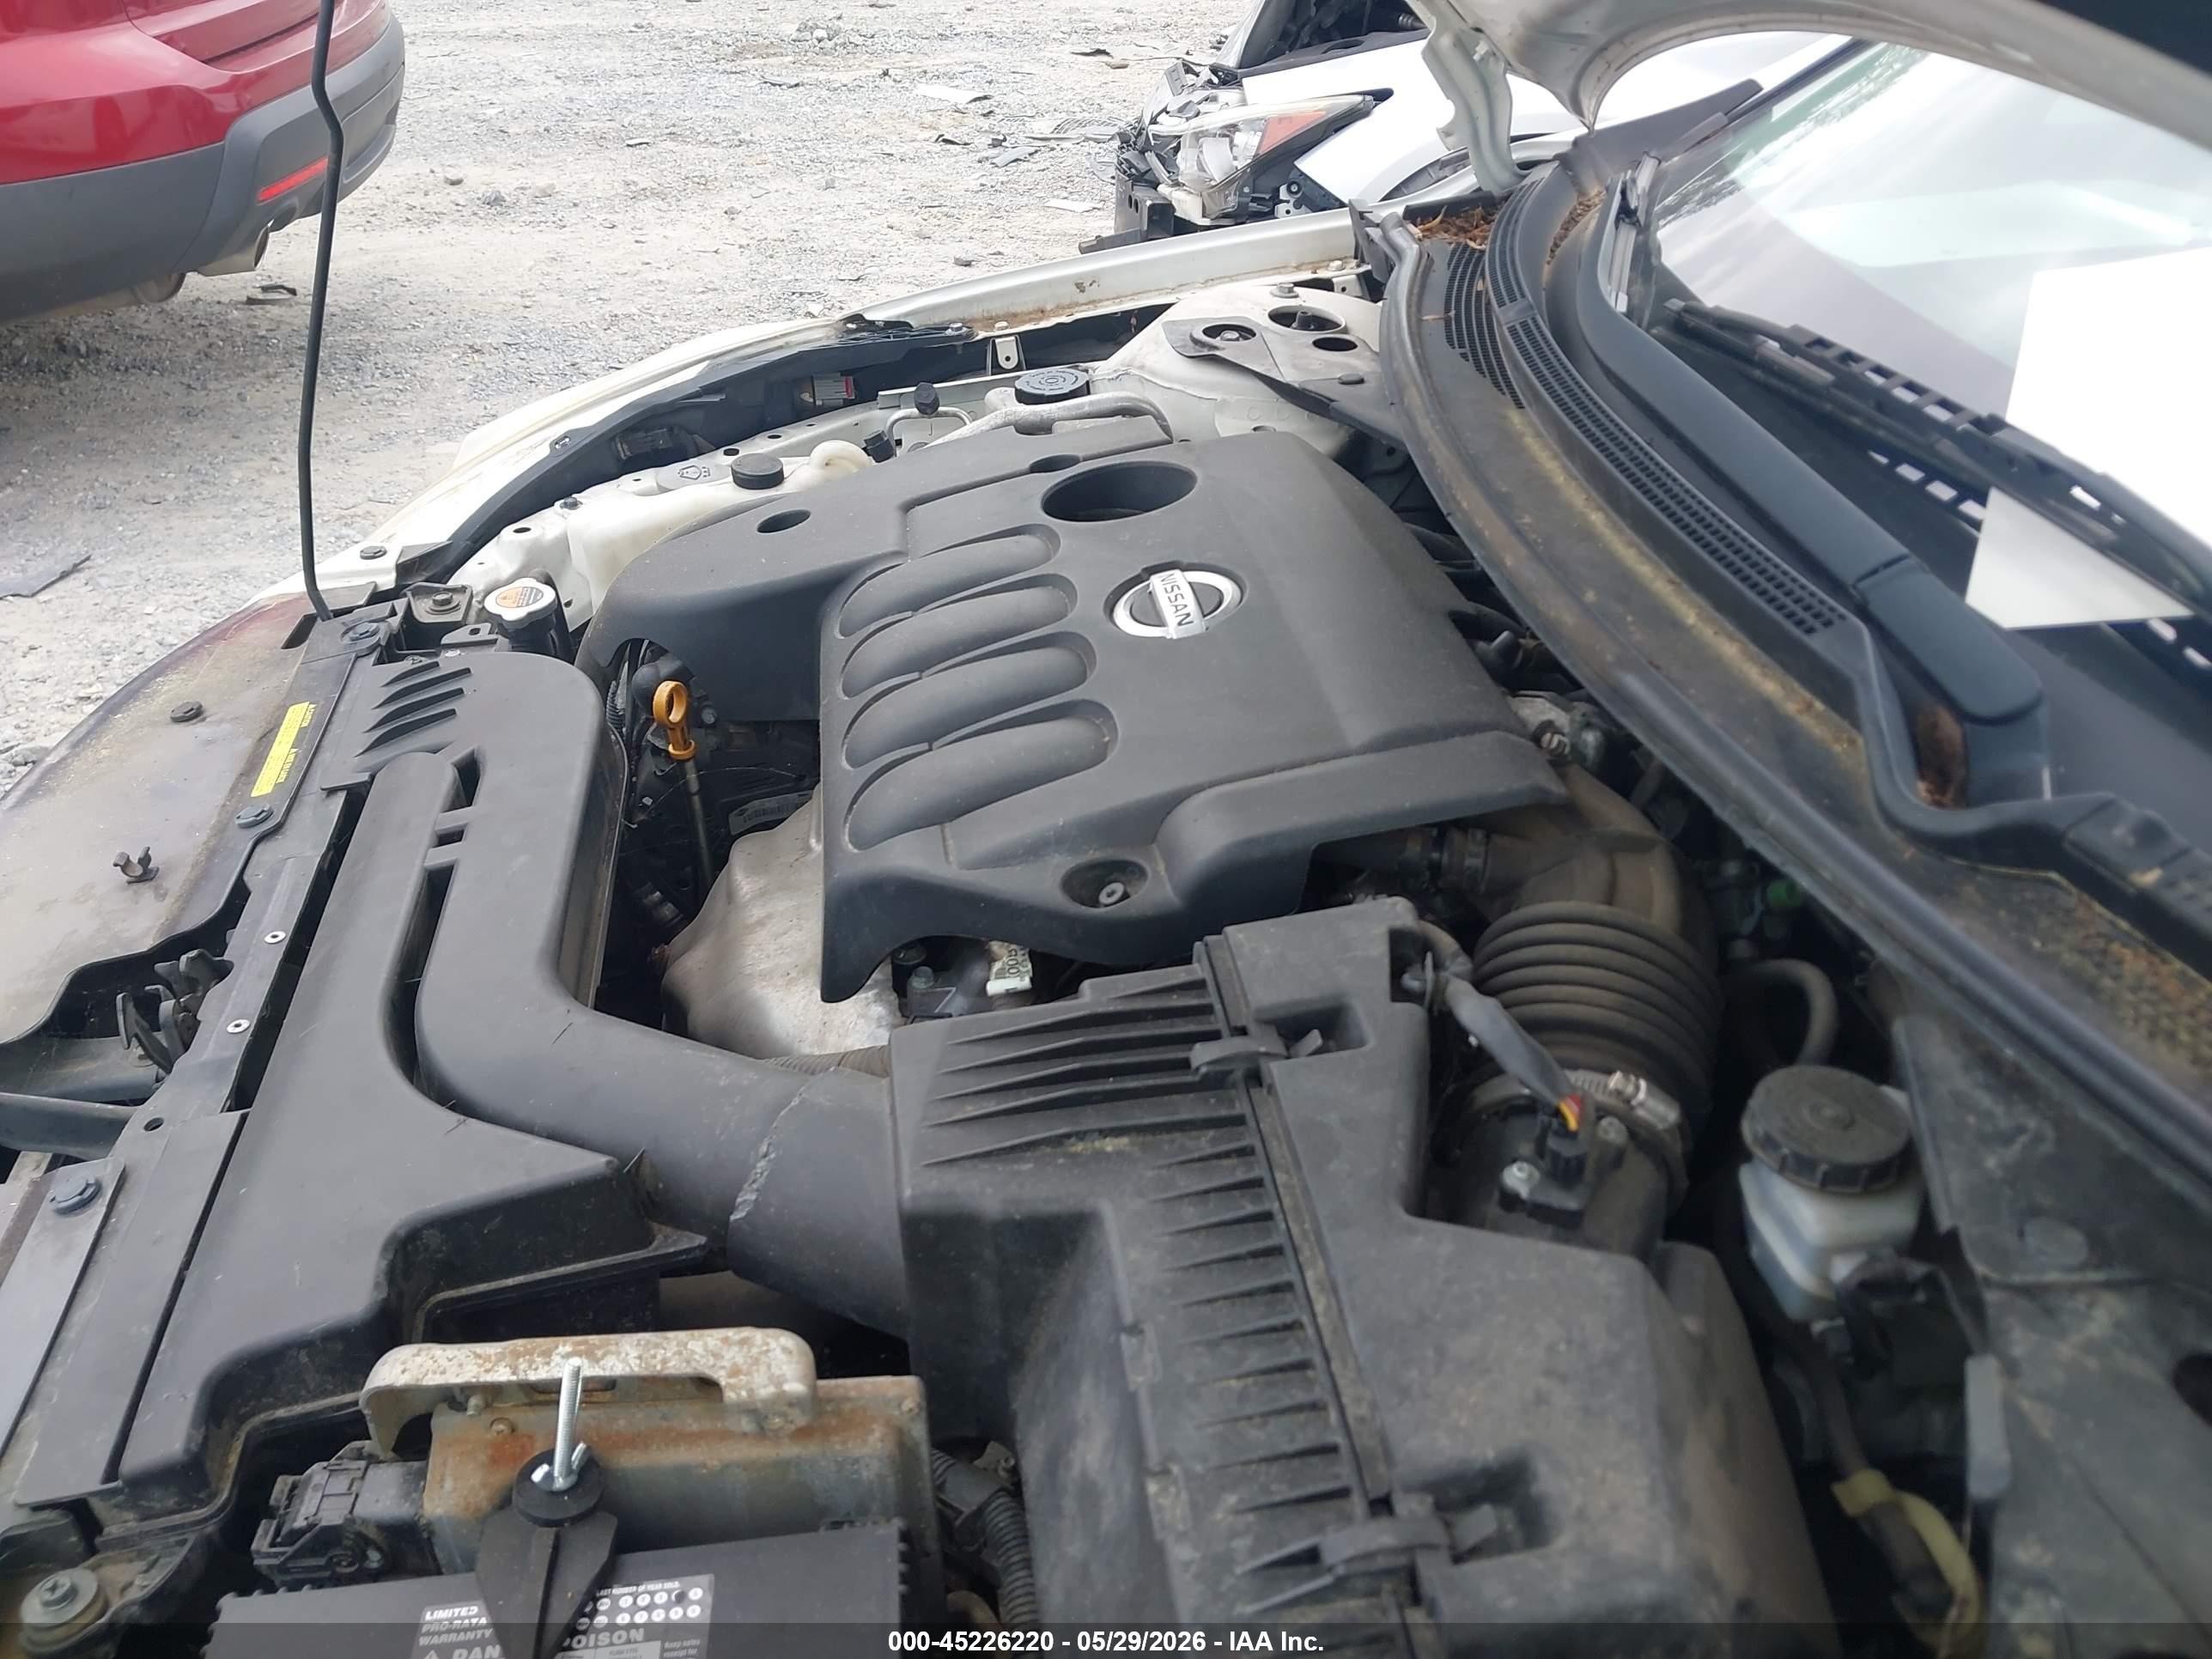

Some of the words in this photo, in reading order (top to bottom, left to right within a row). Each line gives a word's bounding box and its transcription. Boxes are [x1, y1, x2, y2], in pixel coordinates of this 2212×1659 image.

[1160, 572, 1194, 627] NISSAN
[424, 1606, 479, 1620] LIMITED
[422, 1617, 488, 1633] PRO-RATA
[418, 1628, 495, 1646] WARRANTY
